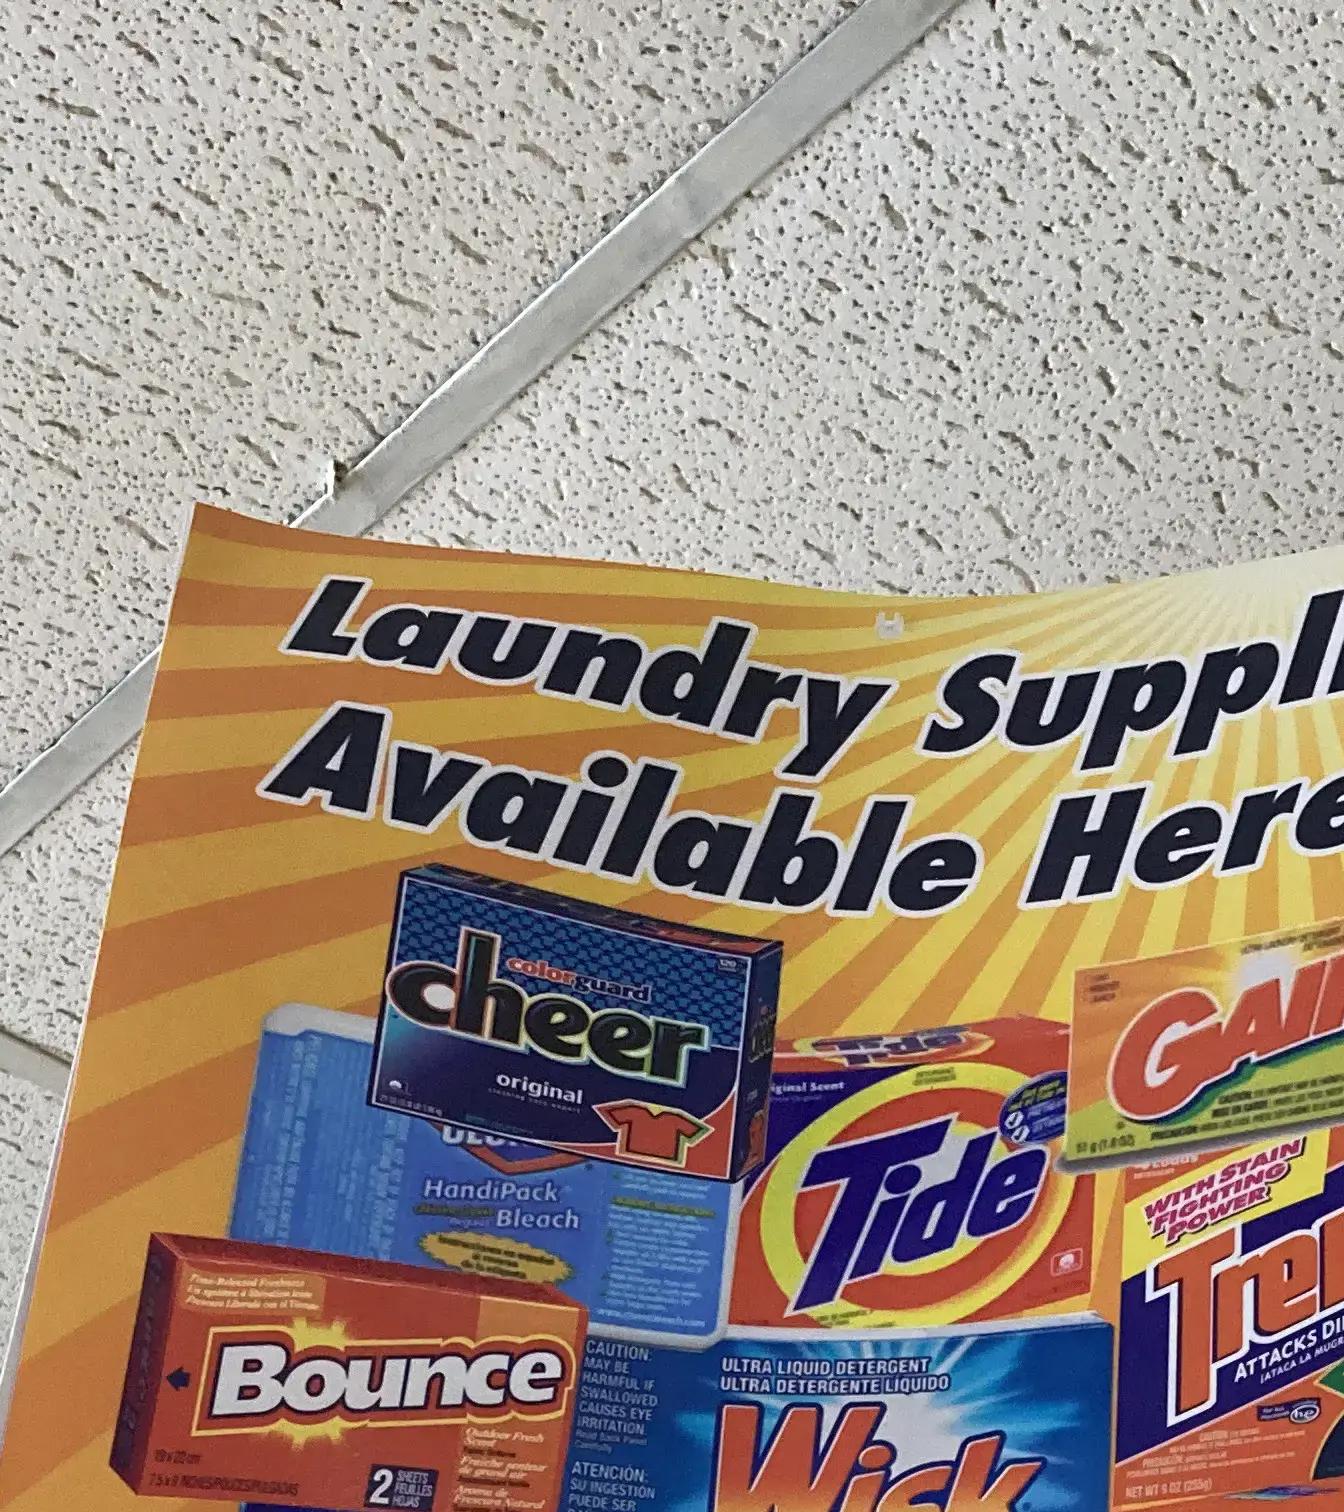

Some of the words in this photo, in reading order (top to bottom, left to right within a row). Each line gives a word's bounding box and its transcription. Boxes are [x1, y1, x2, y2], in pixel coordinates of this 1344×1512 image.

[282, 577, 897, 781] Laundry
[257, 702, 982, 916] Available
[385, 926, 710, 1087] cheer
[496, 1073, 584, 1104] original
[810, 1081, 844, 1092] Scent
[422, 1178, 560, 1201] HandiPack
[1144, 1175, 1216, 1219] WITH
[1219, 1139, 1302, 1183] STAIN
[1153, 1163, 1287, 1233] FIGHTING
[496, 1207, 580, 1229] Bleach
[786, 1114, 1049, 1316] Tide
[1167, 1187, 1268, 1241] POWER
[584, 1357, 611, 1371] MAY
[614, 1361, 629, 1374] BE
[721, 1357, 772, 1374] ULTRA
[777, 1360, 831, 1377] LIQUID
[836, 1358, 930, 1375] DETERGENT
[1234, 1331, 1317, 1383] ATTACKS
[1299, 1353, 1312, 1365] LA
[210, 1341, 563, 1418] Bounce
[583, 1371, 640, 1390] HARMFUL
[644, 1380, 655, 1391] IF
[720, 1377, 771, 1393] ULTRA
[776, 1378, 880, 1393] DETERGENTE
[580, 1386, 658, 1407] SWALLOWED
[579, 1400, 626, 1418] CAUSES
[630, 1407, 653, 1421] EYE
[369, 1468, 394, 1505] 2
[396, 1470, 430, 1484] SHEETS
[570, 1478, 587, 1491] SU
[392, 1494, 420, 1508] HOJAS
[569, 1493, 609, 1509] PUEDE
[612, 1499, 636, 1512] SER
